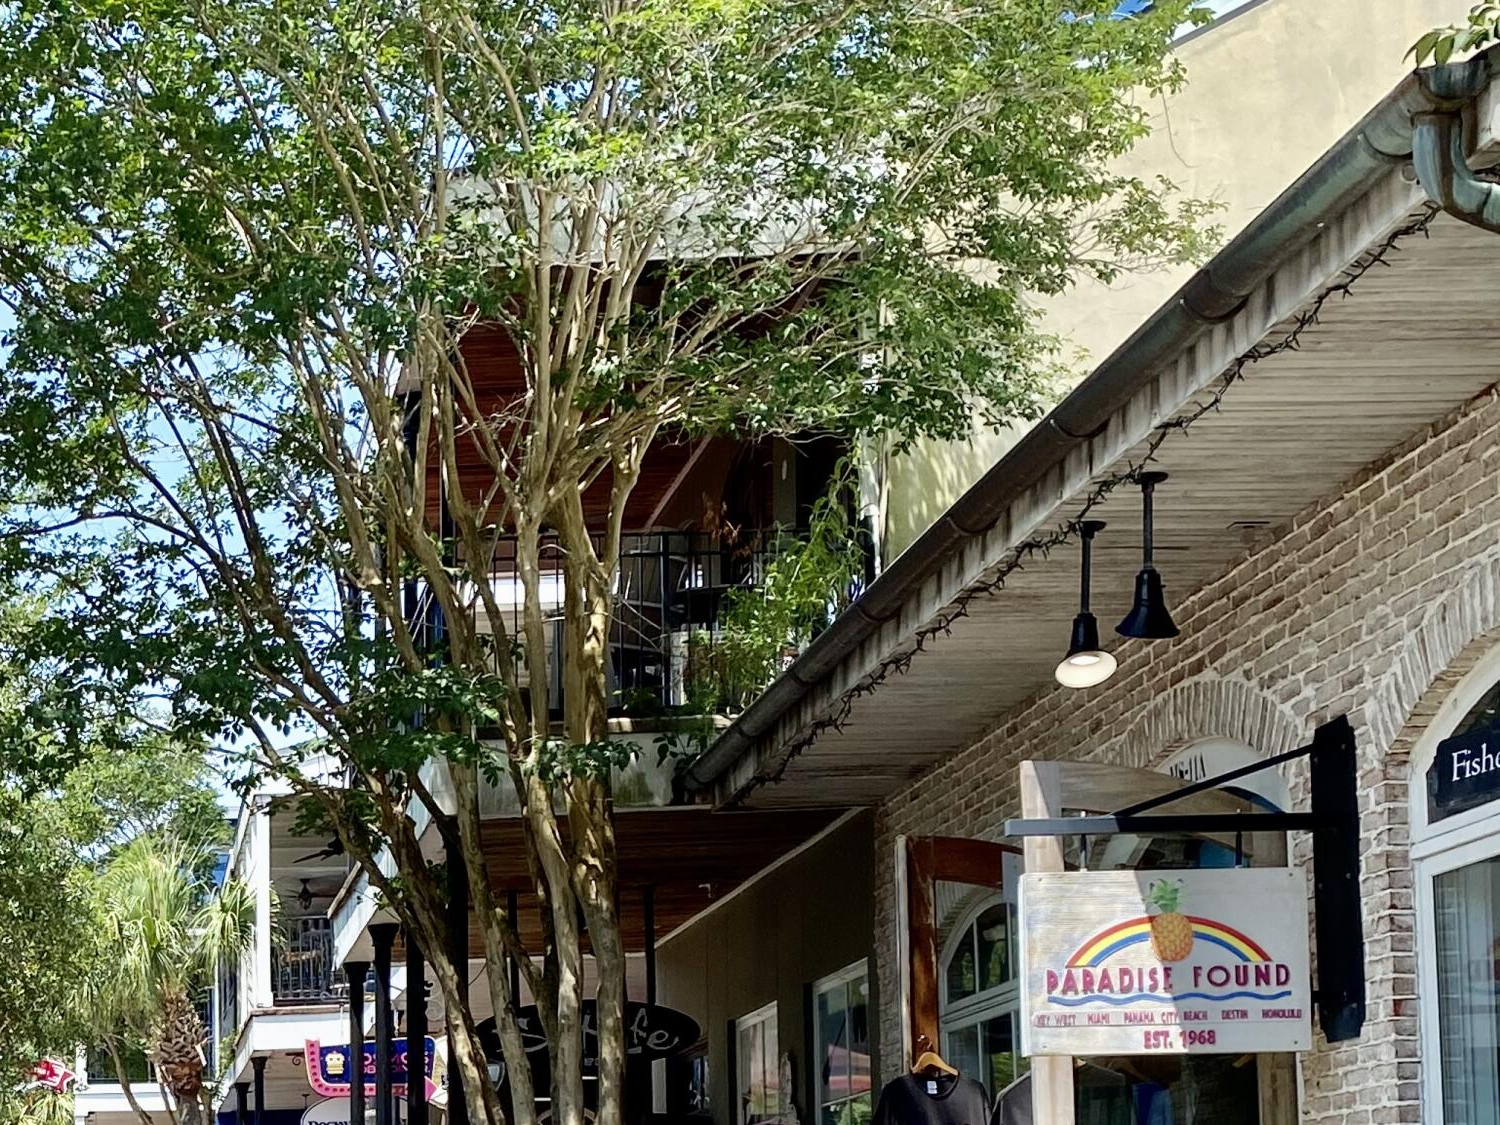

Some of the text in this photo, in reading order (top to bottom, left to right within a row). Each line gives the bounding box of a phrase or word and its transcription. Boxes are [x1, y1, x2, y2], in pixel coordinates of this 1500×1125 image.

[1046, 963, 1290, 996] PARADISE FOUND
[1087, 1012, 1110, 1025] MIAMI
[1123, 1011, 1156, 1025] PANAMA
[1161, 1011, 1178, 1025] CITY
[1182, 1010, 1209, 1022] BEACH
[1221, 1009, 1248, 1020] DESTIN
[1261, 1008, 1303, 1020] HONOLULU
[1143, 1029, 1216, 1049] EST. 1968
